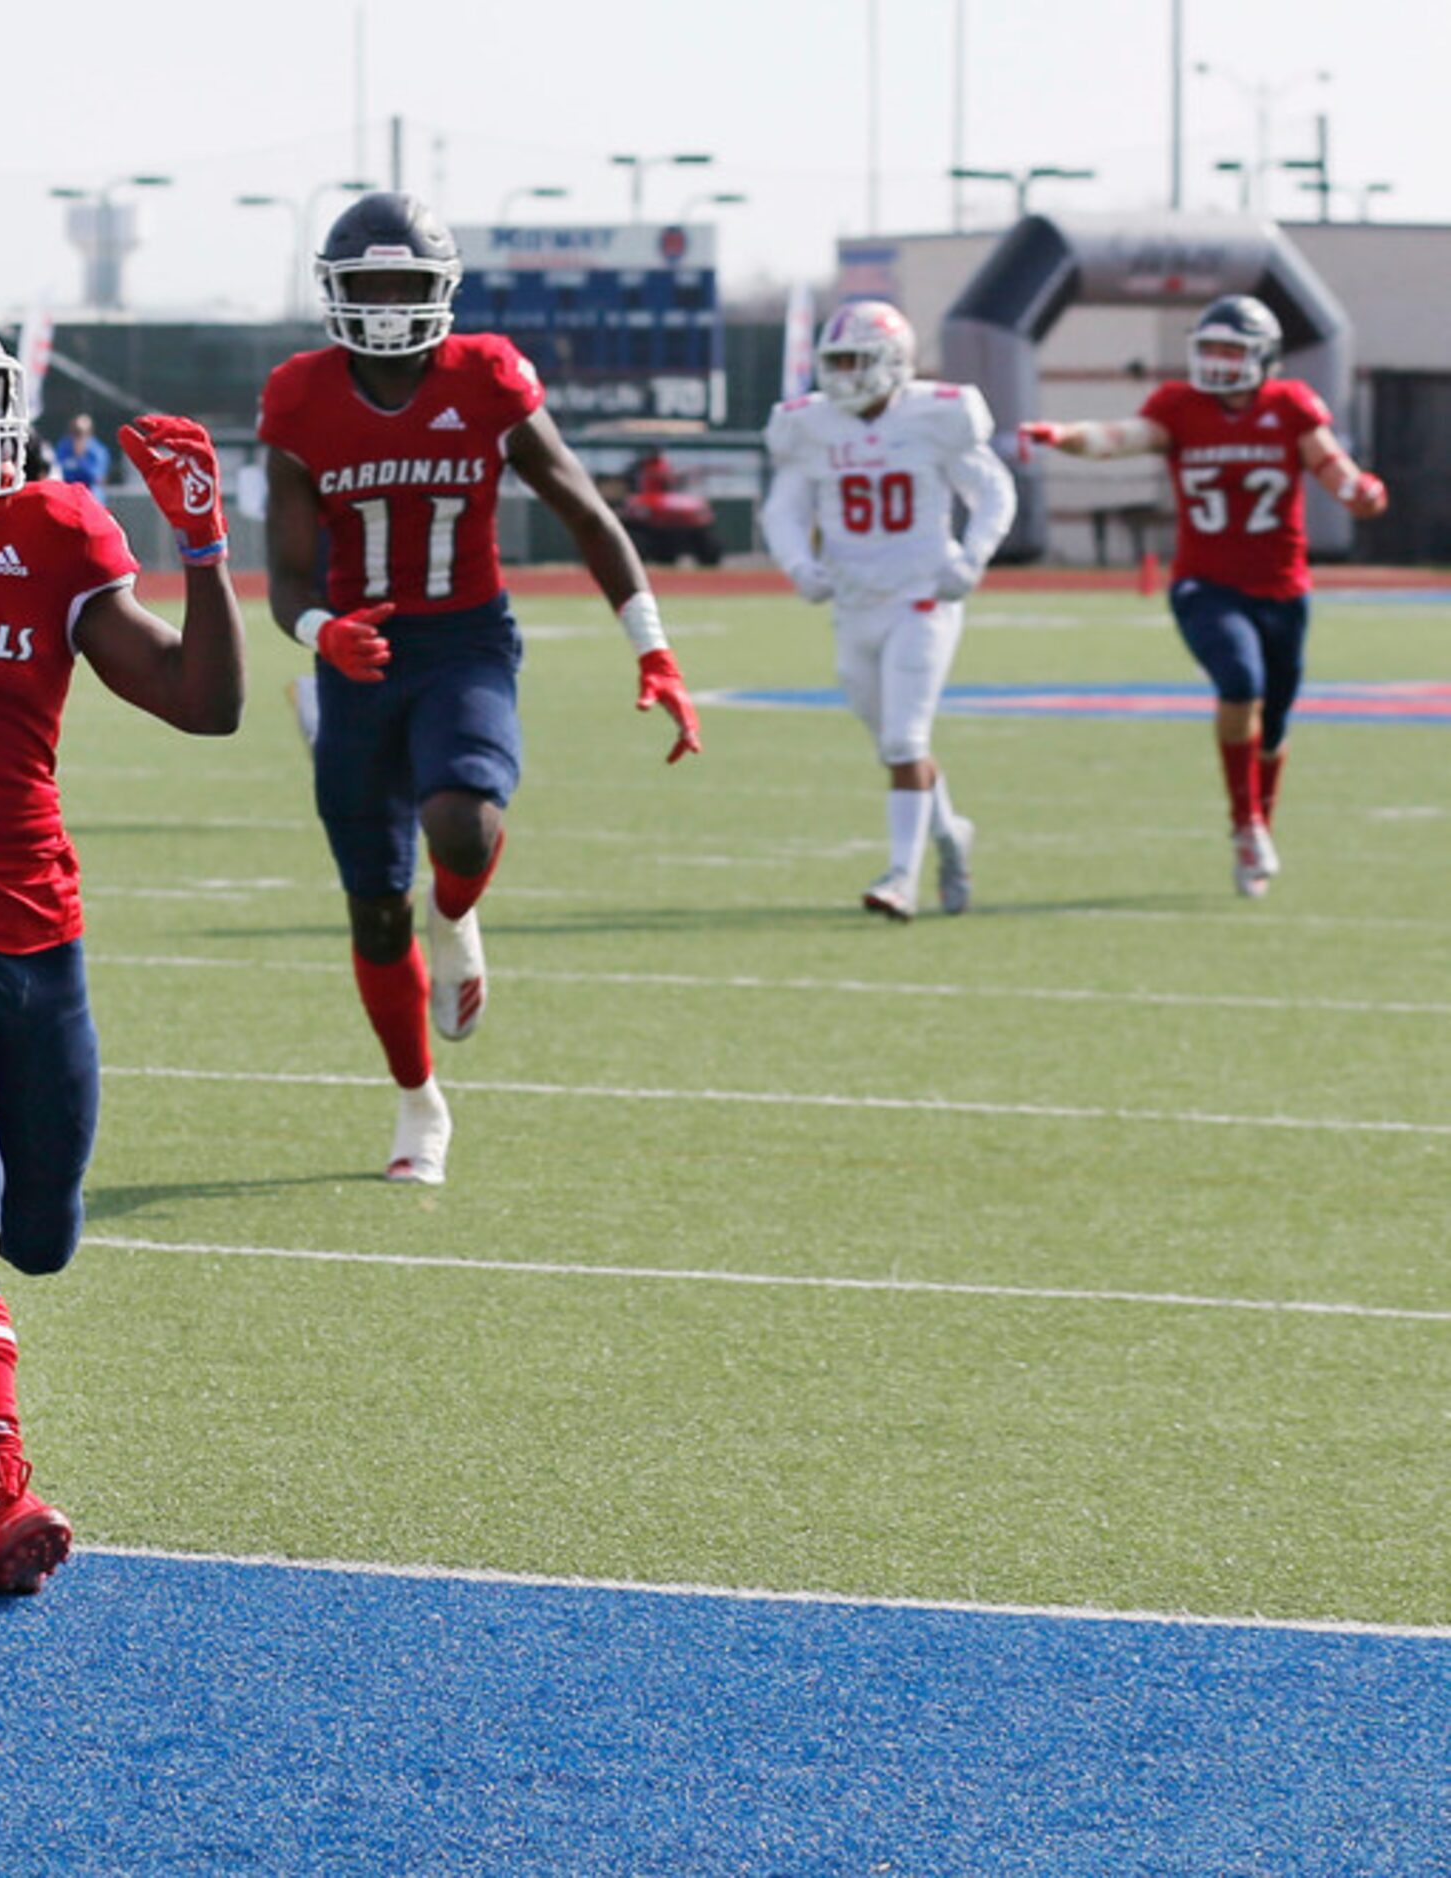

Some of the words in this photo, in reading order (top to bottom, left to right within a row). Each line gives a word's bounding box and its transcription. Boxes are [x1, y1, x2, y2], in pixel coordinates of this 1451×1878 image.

[319, 457, 485, 495] CARDINALS
[840, 472, 913, 534] 60
[1180, 467, 1290, 534] 52
[347, 496, 469, 598] 11
